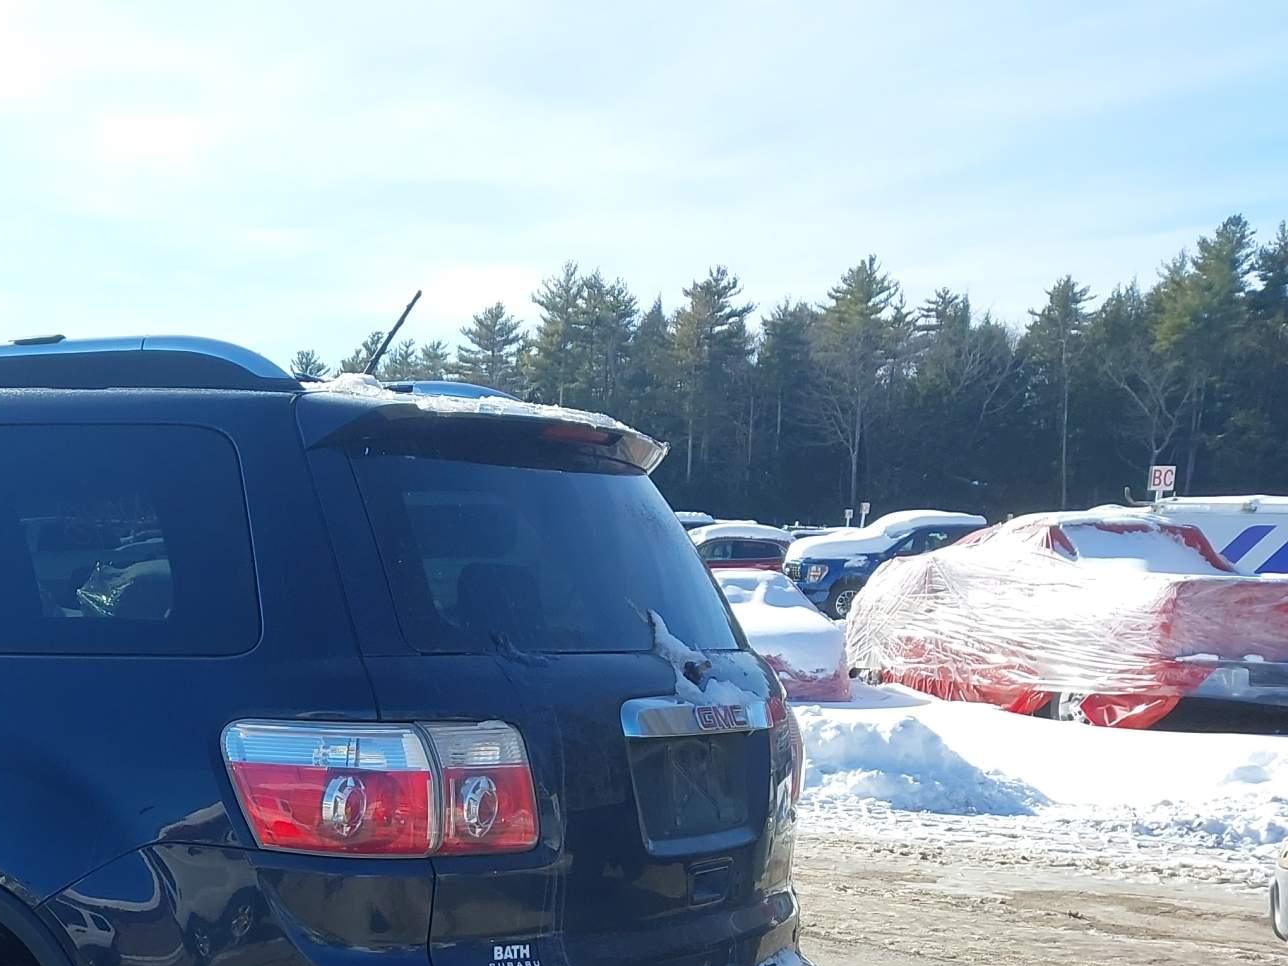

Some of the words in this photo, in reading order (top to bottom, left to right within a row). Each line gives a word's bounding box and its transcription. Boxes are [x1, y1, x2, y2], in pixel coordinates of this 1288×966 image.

[1152, 469, 1174, 487] BC
[696, 704, 746, 730] GMC
[493, 944, 530, 960] BATH
